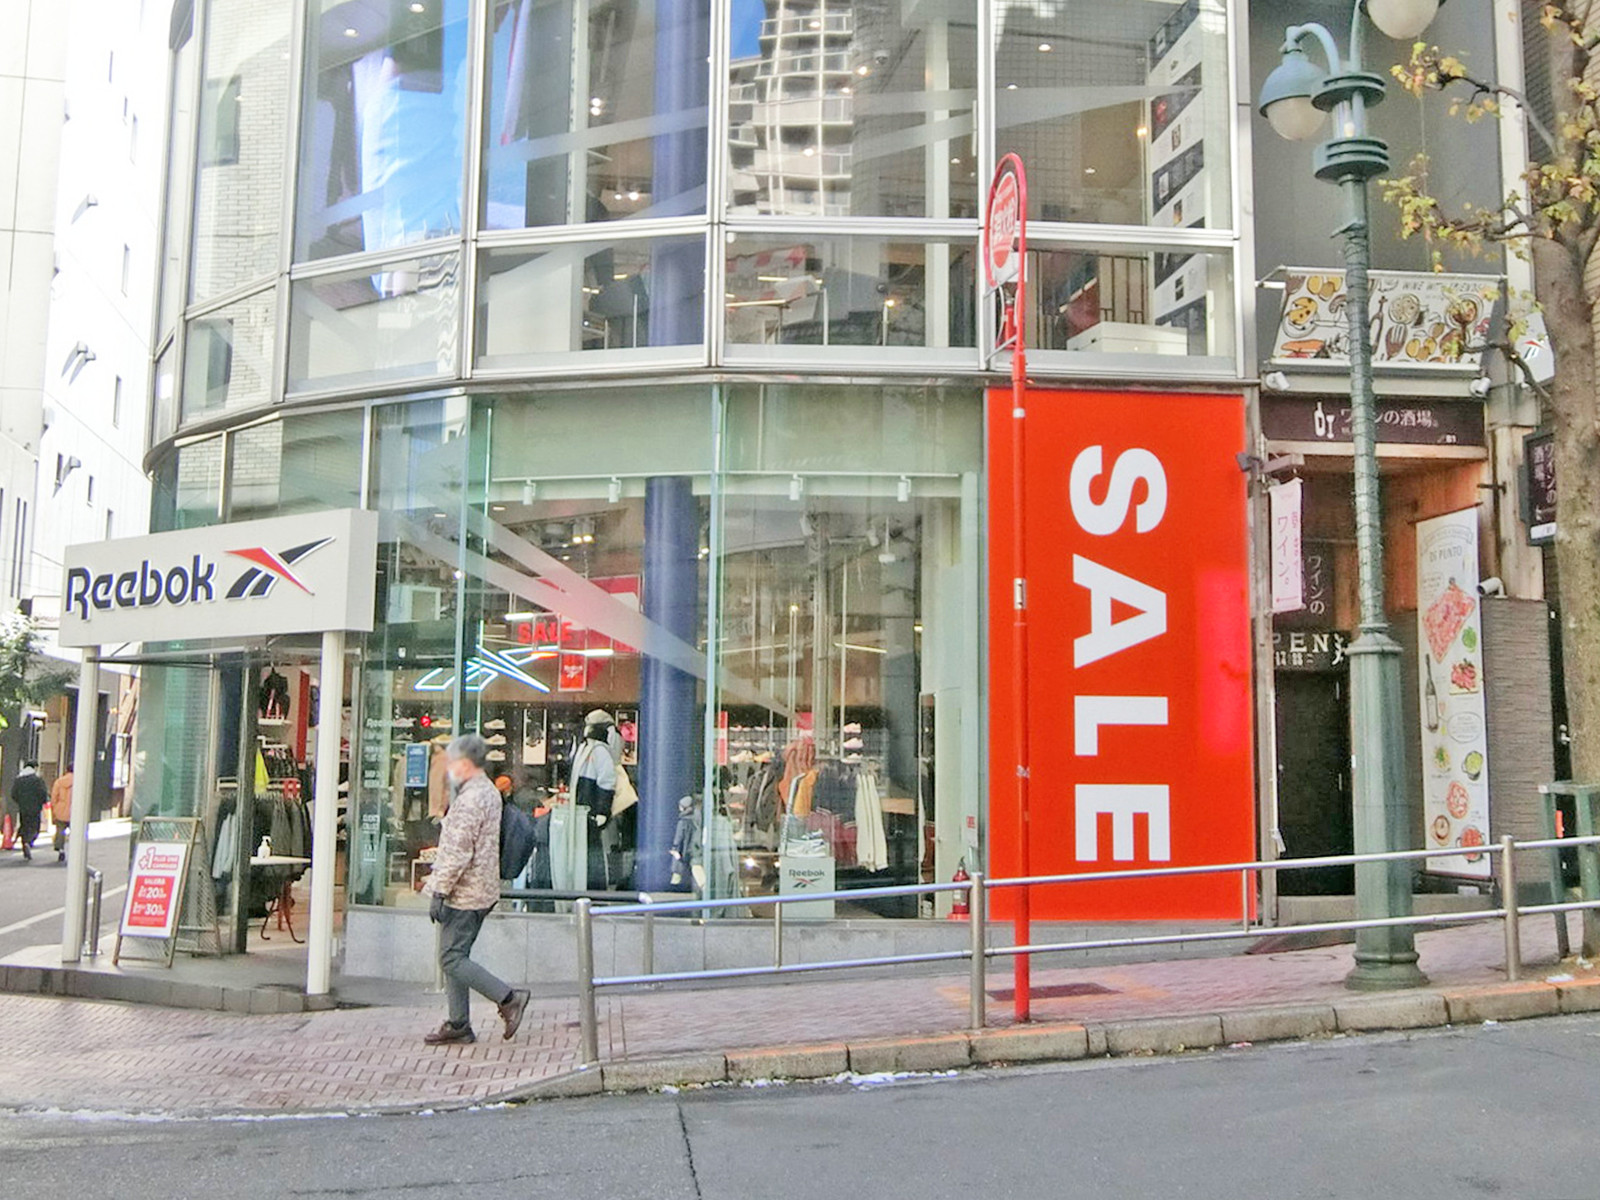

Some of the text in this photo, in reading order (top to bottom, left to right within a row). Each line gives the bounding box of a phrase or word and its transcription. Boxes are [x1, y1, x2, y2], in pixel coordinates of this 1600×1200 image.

[66, 554, 216, 621] Reebok
[517, 622, 573, 643] SALE
[1069, 444, 1171, 862] SALE
[788, 868, 825, 878] Reebok
